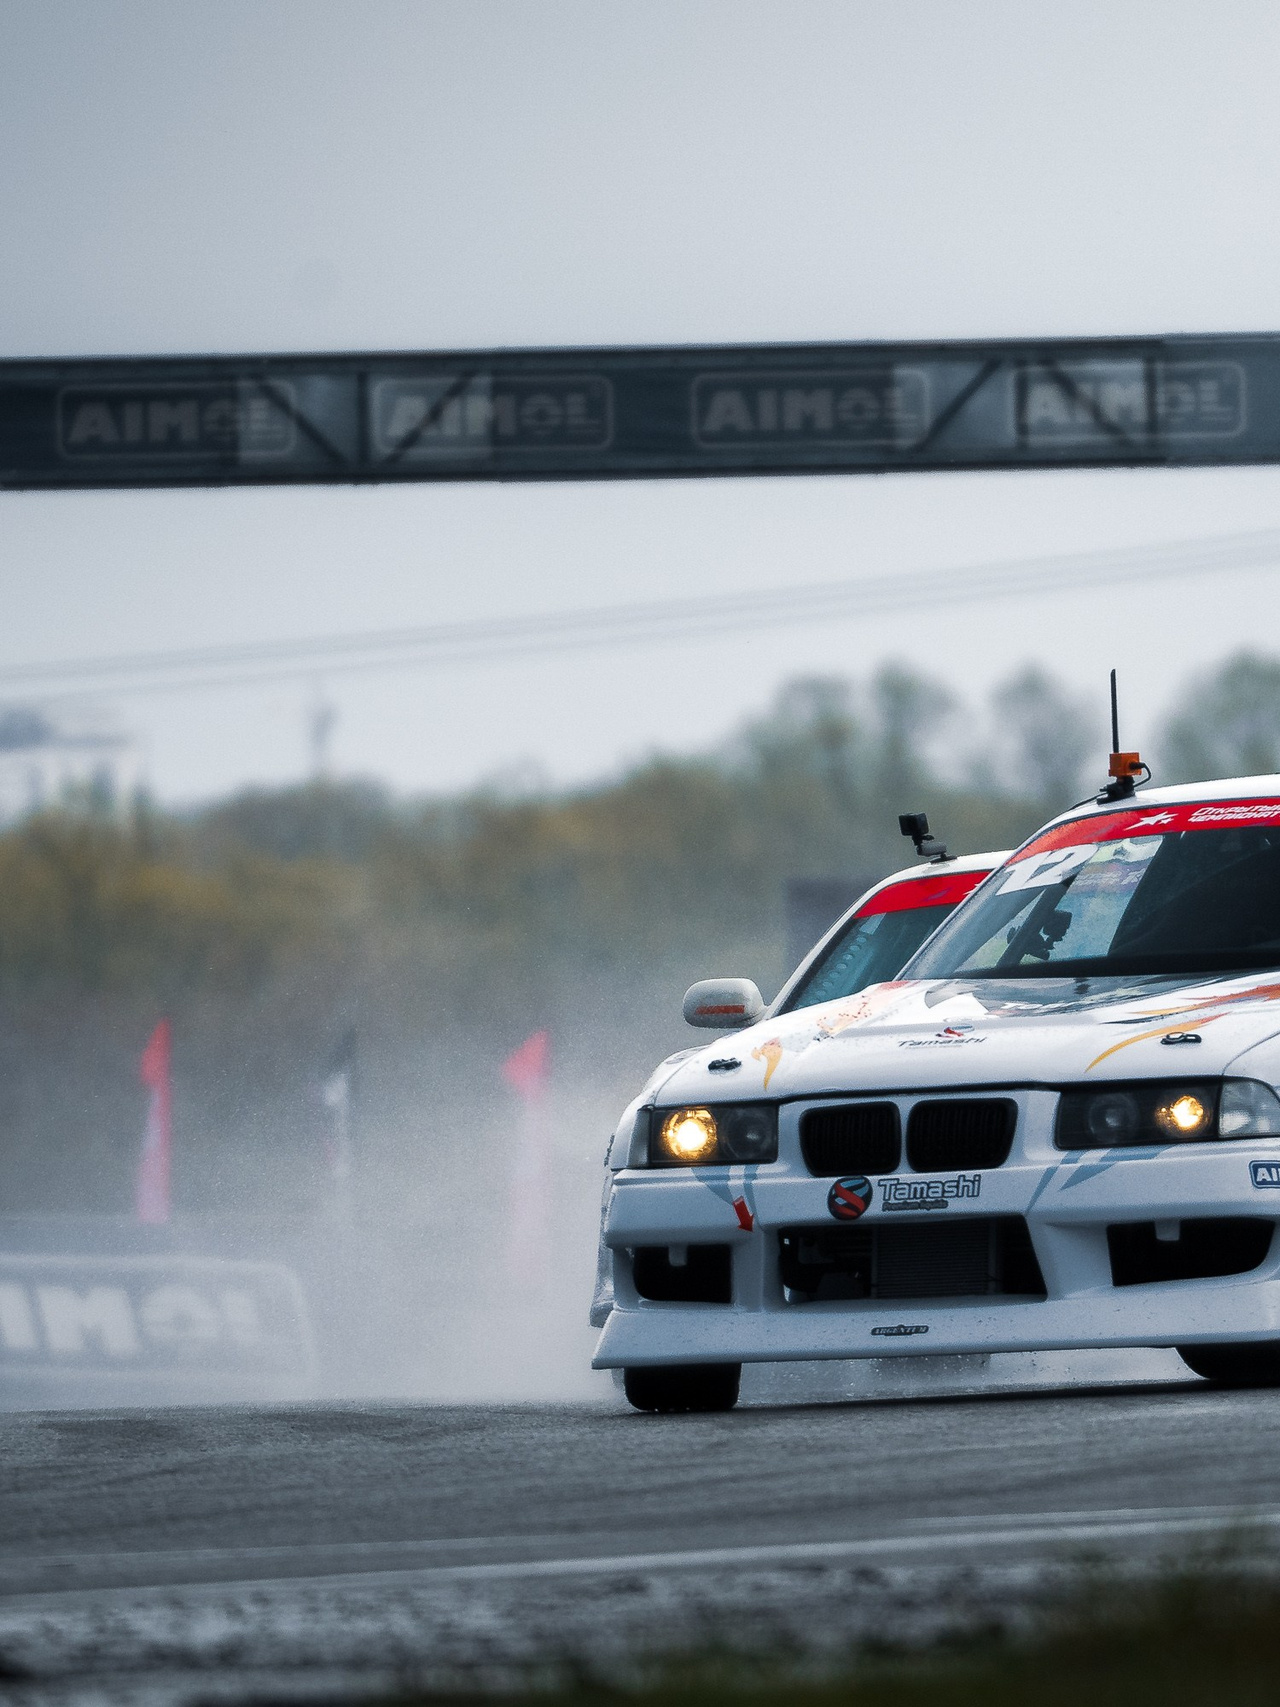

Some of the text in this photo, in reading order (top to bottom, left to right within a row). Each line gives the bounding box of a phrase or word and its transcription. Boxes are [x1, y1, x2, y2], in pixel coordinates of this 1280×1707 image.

[66, 402, 284, 444] AIMOL
[379, 392, 597, 438] AIMOL
[701, 387, 932, 431] AIMOL
[1024, 380, 1237, 426] AIMOL
[995, 843, 1099, 896] 12
[878, 1174, 981, 1201] Tamashi
